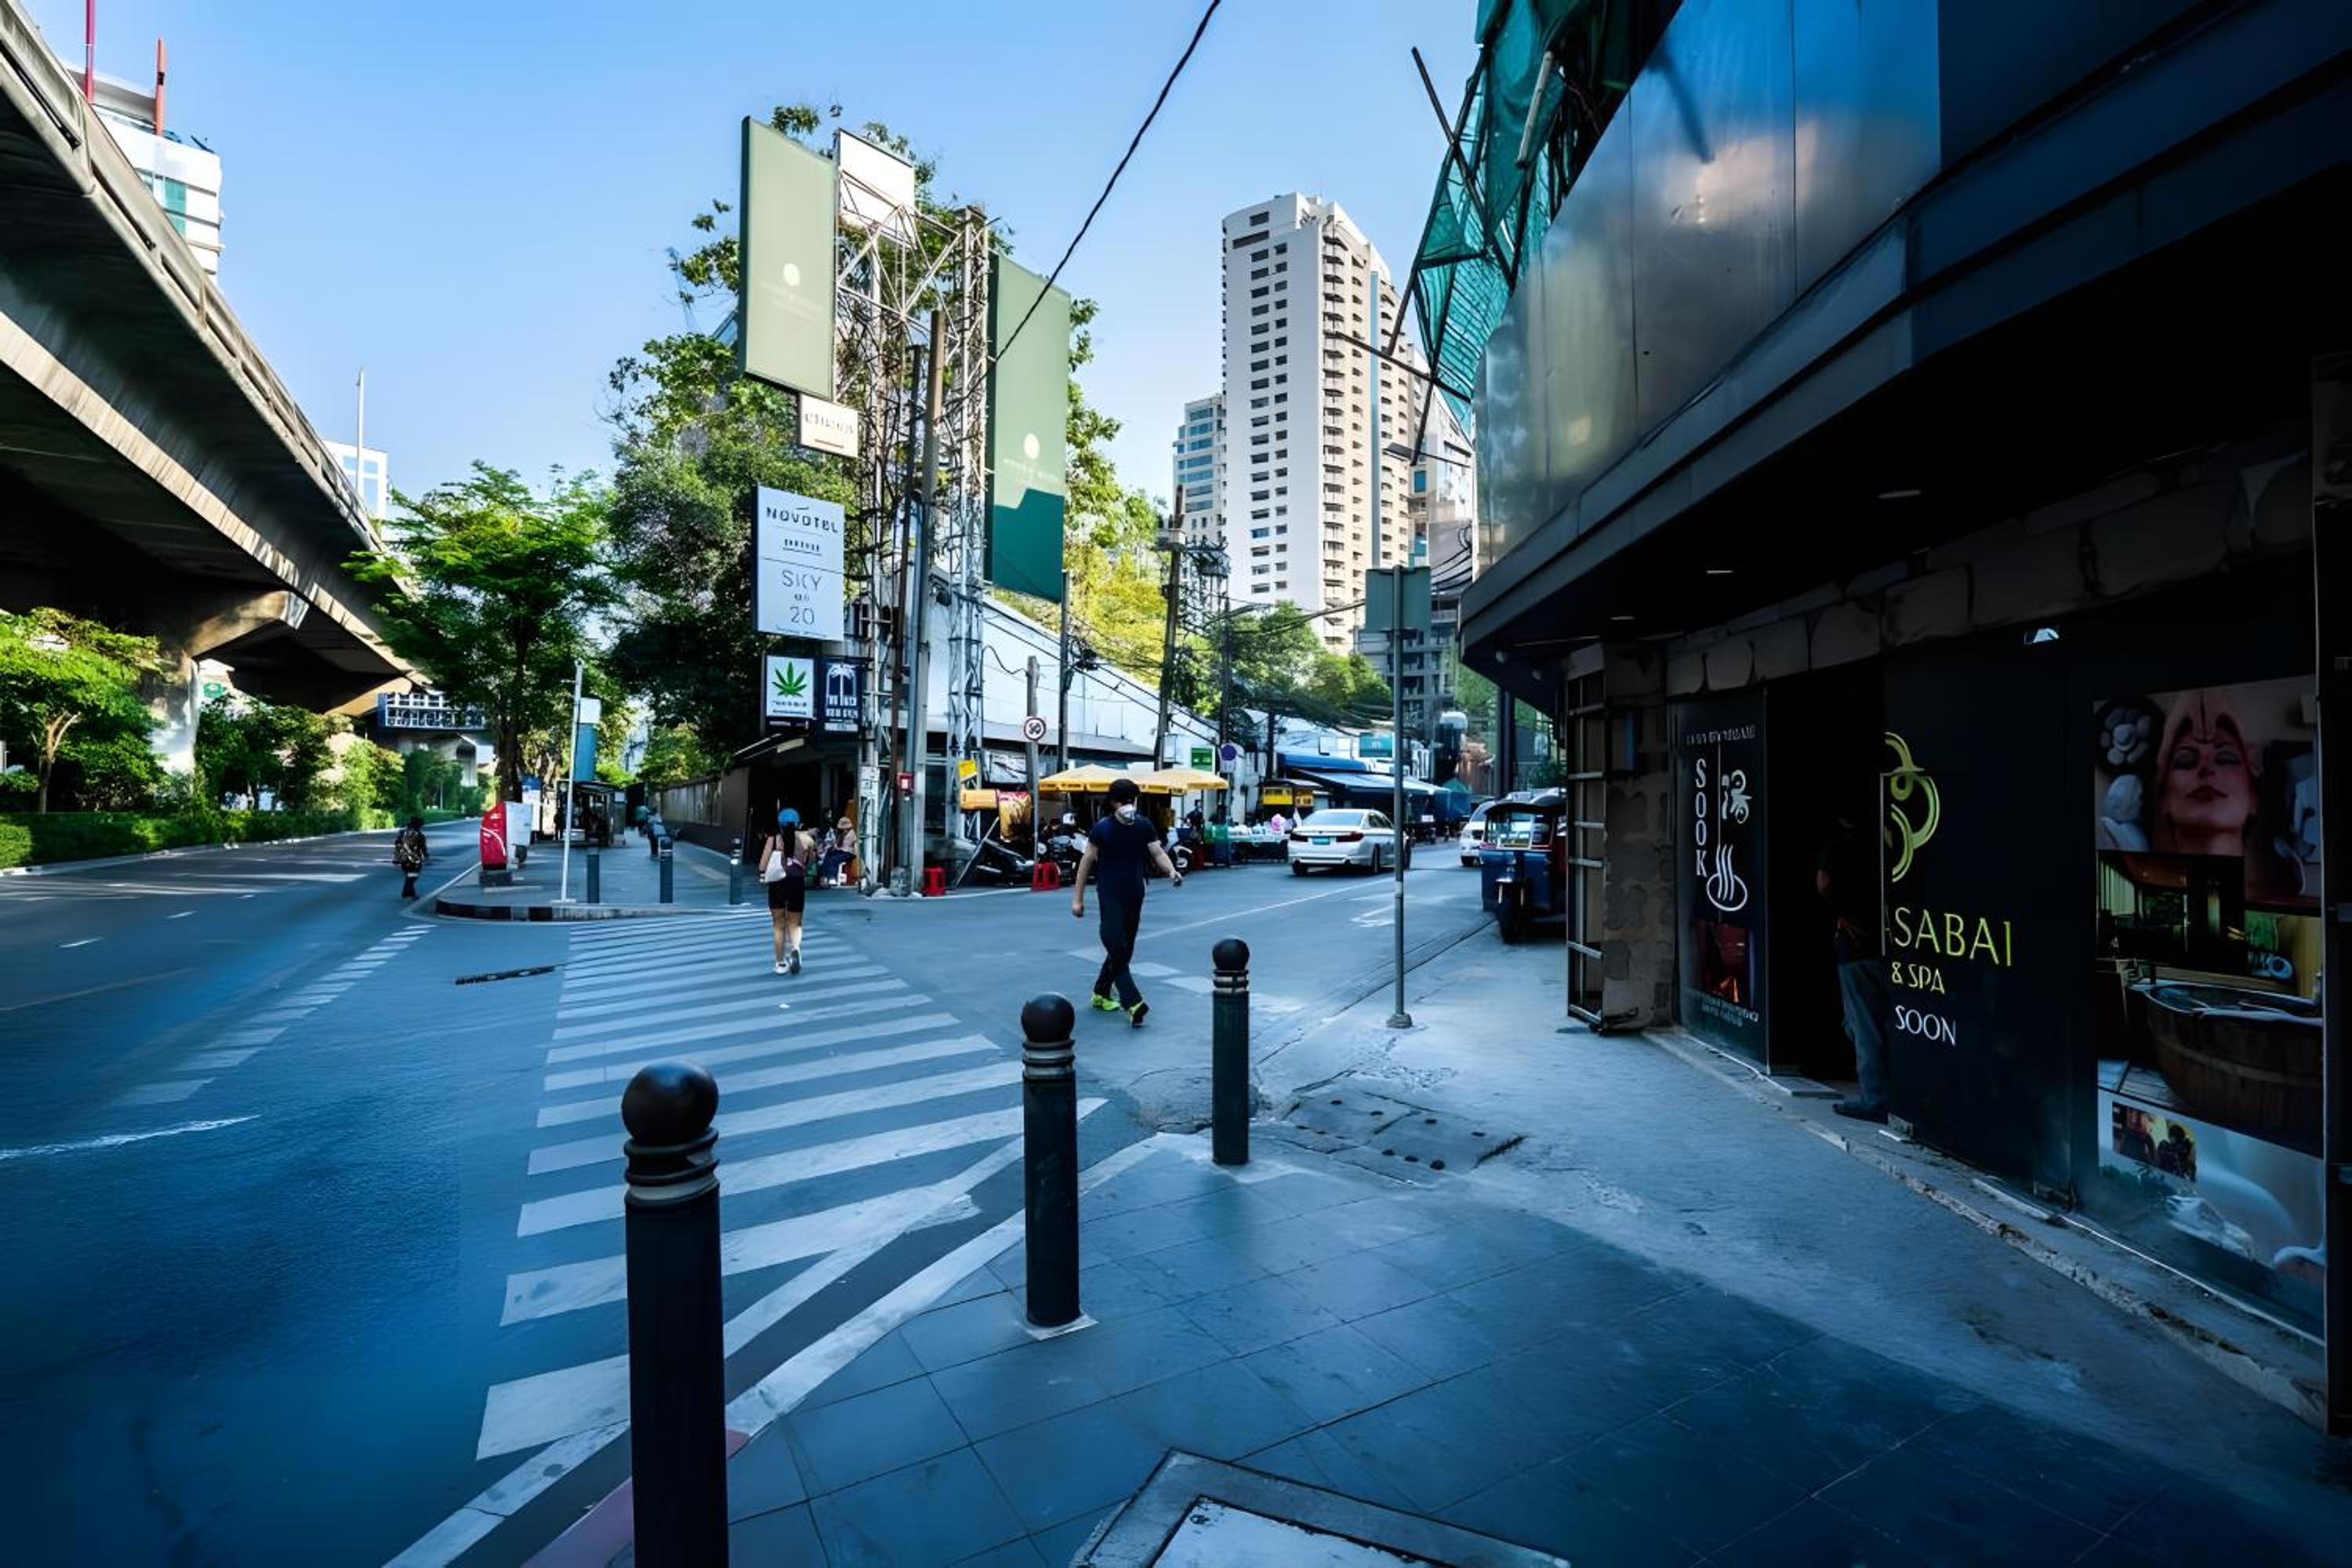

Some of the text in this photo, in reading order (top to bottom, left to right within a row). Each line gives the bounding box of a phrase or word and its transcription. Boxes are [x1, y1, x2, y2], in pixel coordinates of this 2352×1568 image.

[766, 506, 838, 533] NOVOTEL
[789, 606, 815, 625] 20
[1695, 758, 1707, 877] SOOK
[1892, 961, 1945, 994] & SPA
[1895, 1004, 1957, 1046] SOON
